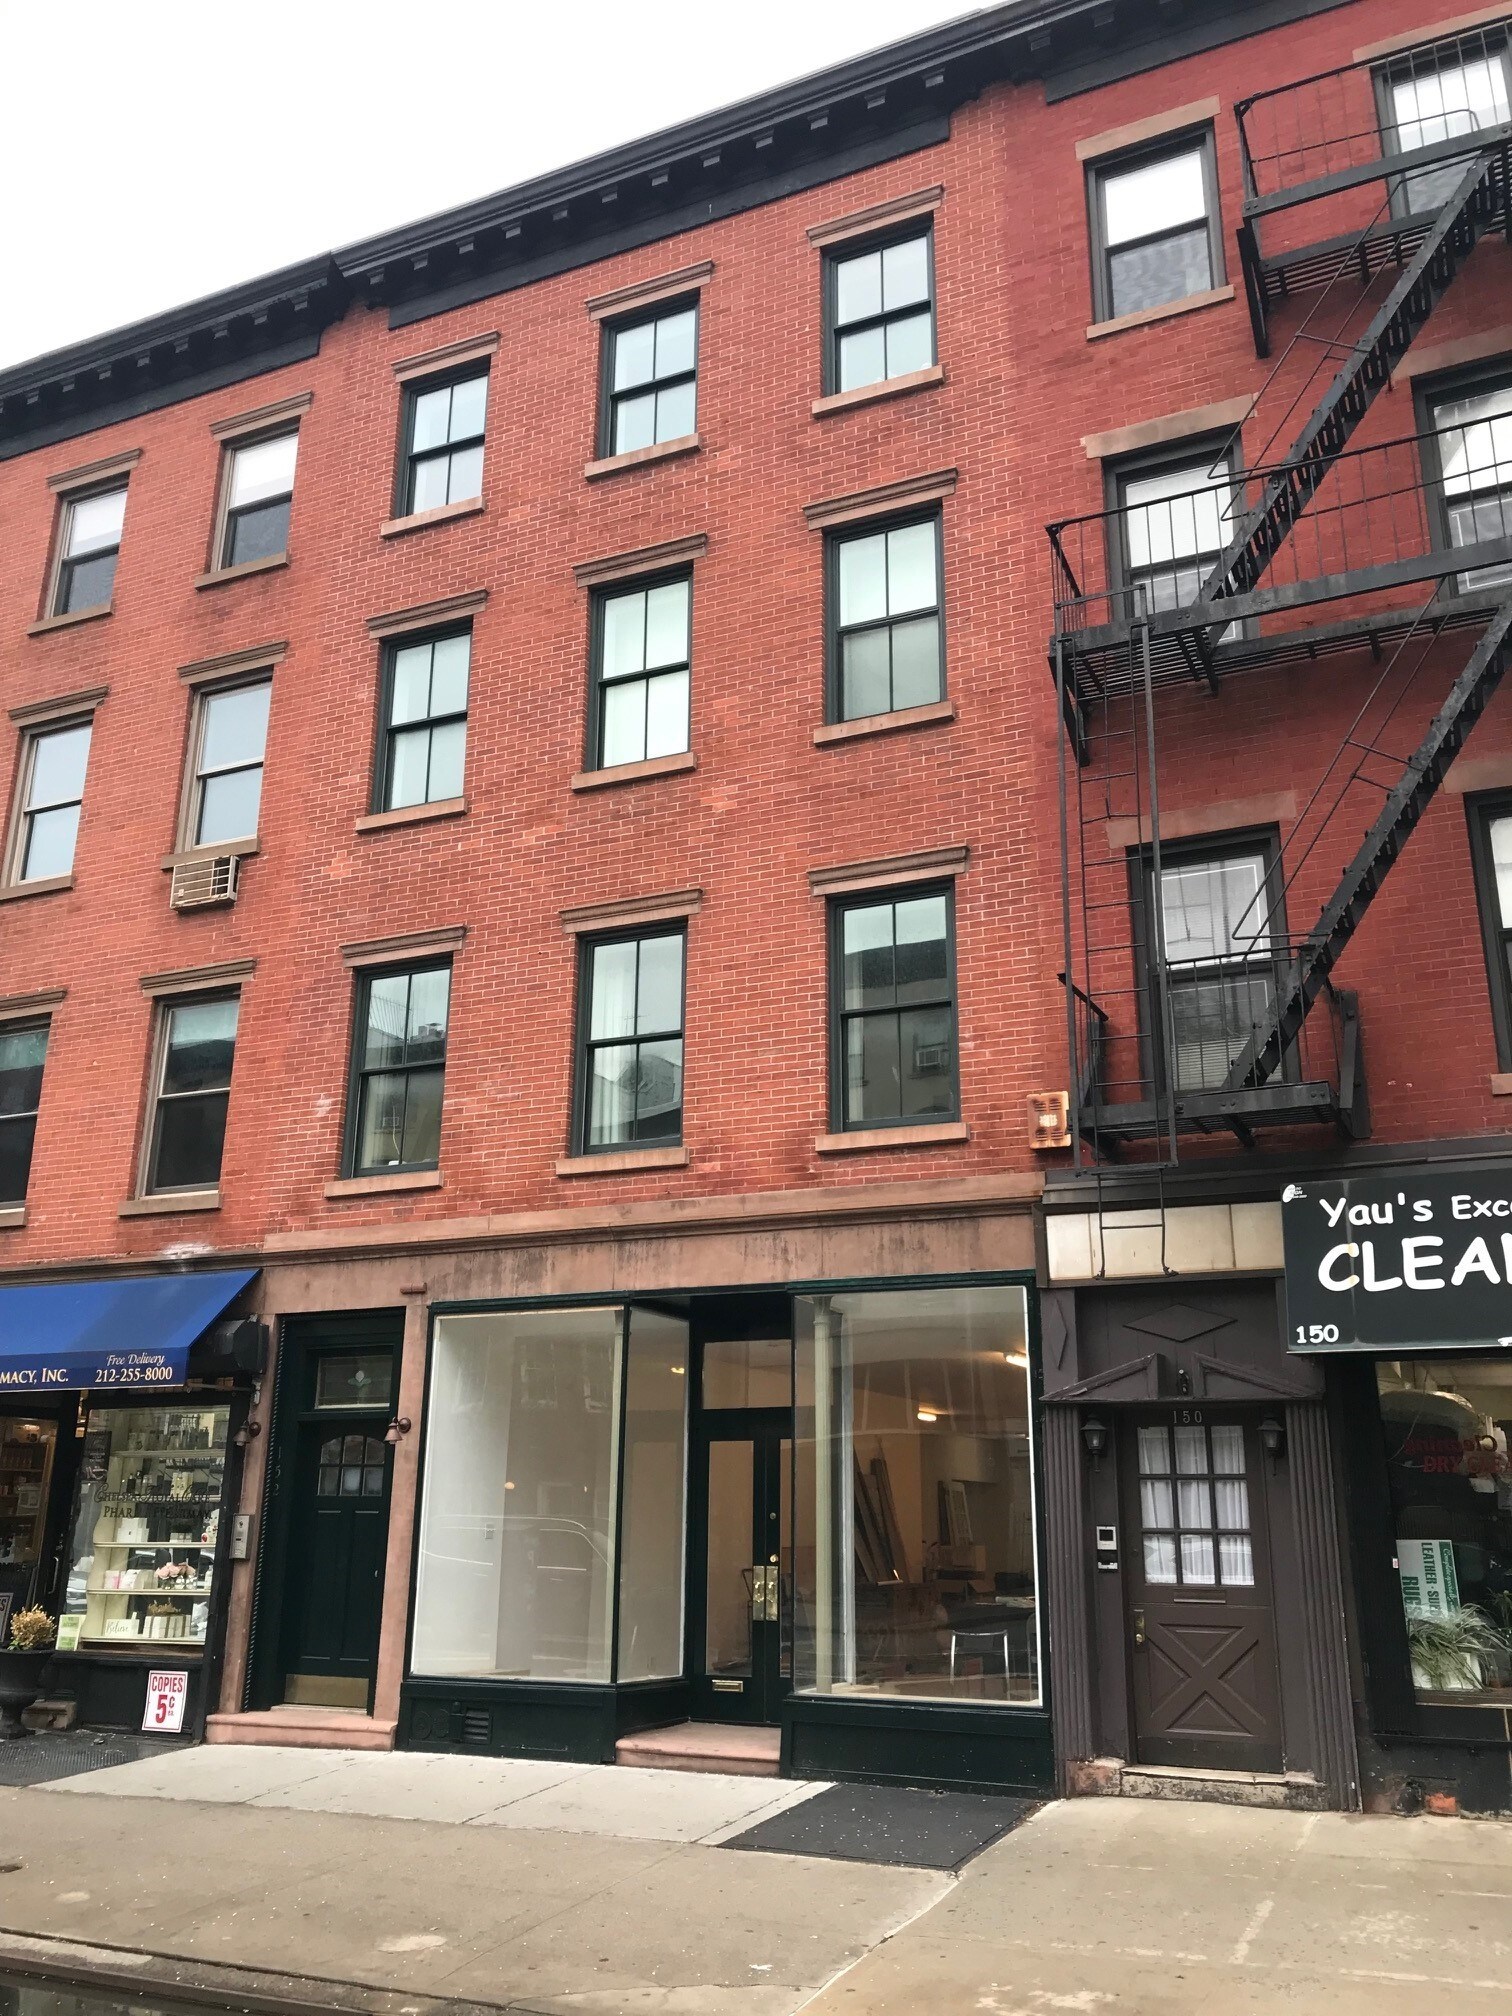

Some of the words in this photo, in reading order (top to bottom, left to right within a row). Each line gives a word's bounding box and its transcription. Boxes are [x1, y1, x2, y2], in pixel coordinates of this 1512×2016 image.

[1319, 1192, 1434, 1228] Yau's
[1451, 1194, 1512, 1220] Exc
[1296, 1324, 1340, 1344] 150
[106, 1354, 125, 1367] Free
[127, 1352, 165, 1367] Delivery
[41, 1367, 69, 1383] INC.
[95, 1366, 173, 1383] 212-255-8000
[1172, 1410, 1203, 1424] 150
[1421, 1542, 1438, 1585] LEATHER
[151, 1675, 184, 1693] COPIES
